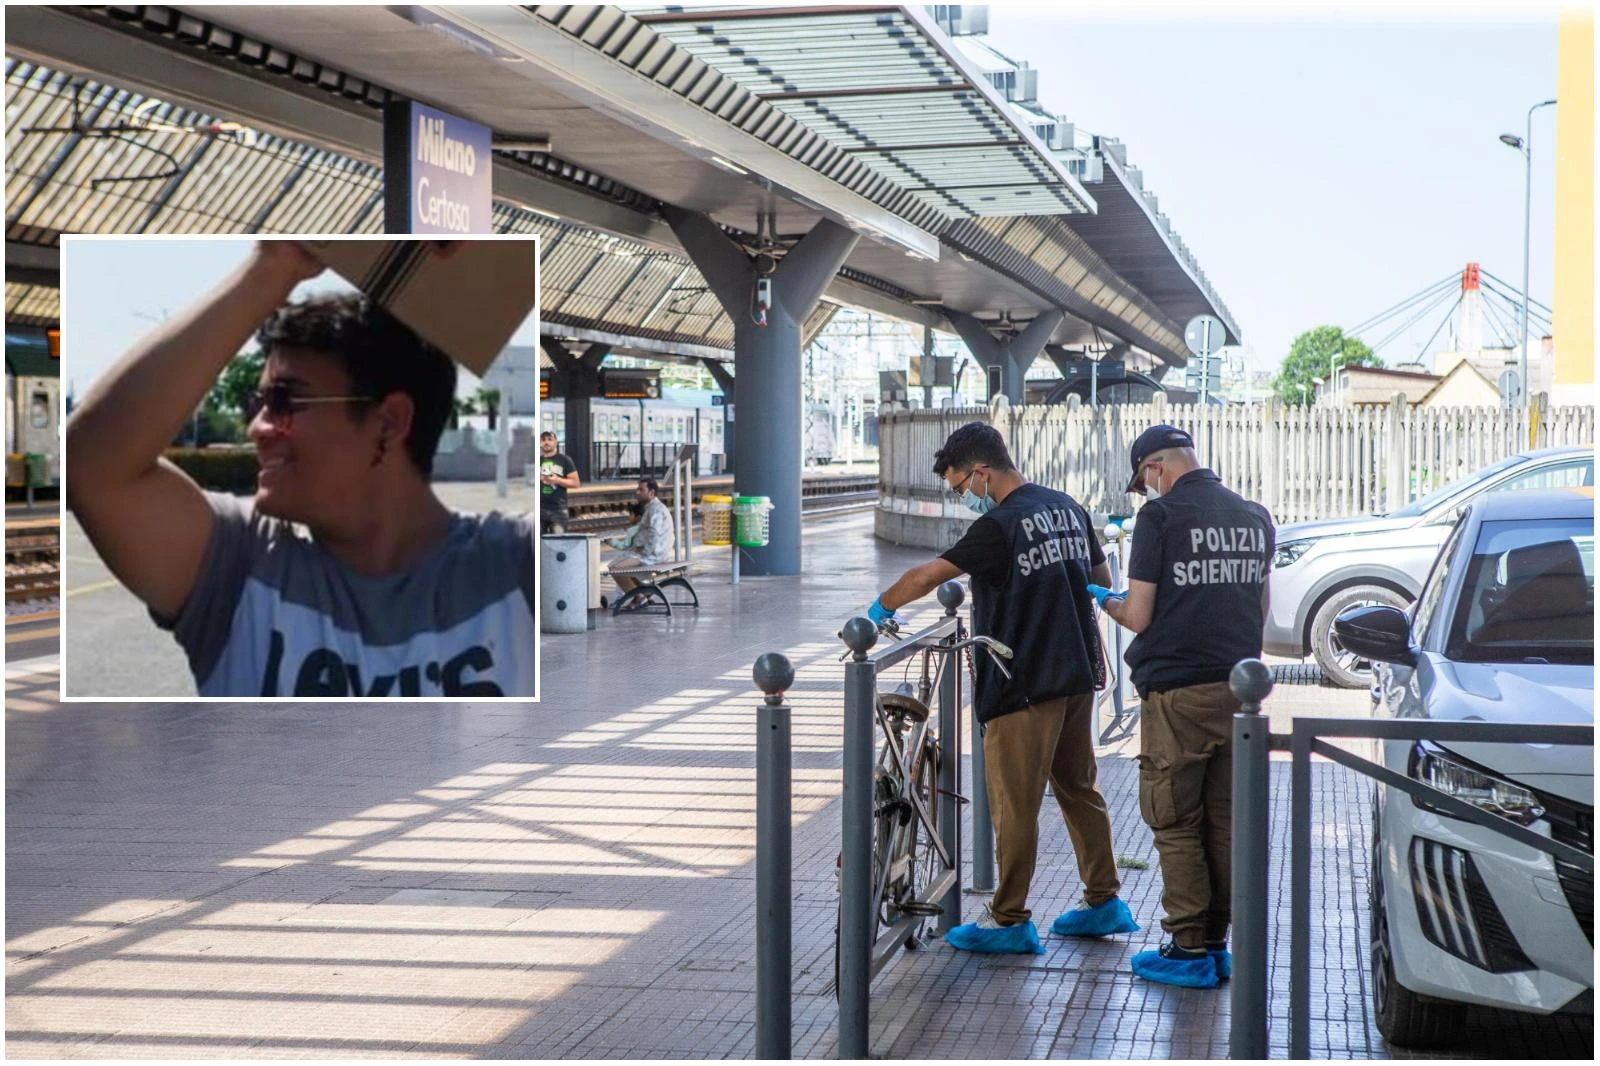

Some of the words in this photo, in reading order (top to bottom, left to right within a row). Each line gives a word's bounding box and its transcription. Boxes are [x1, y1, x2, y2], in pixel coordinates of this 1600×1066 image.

[417, 114, 476, 177] Milano
[417, 176, 470, 233] Certosa
[1190, 527, 1266, 553] POLIZIA
